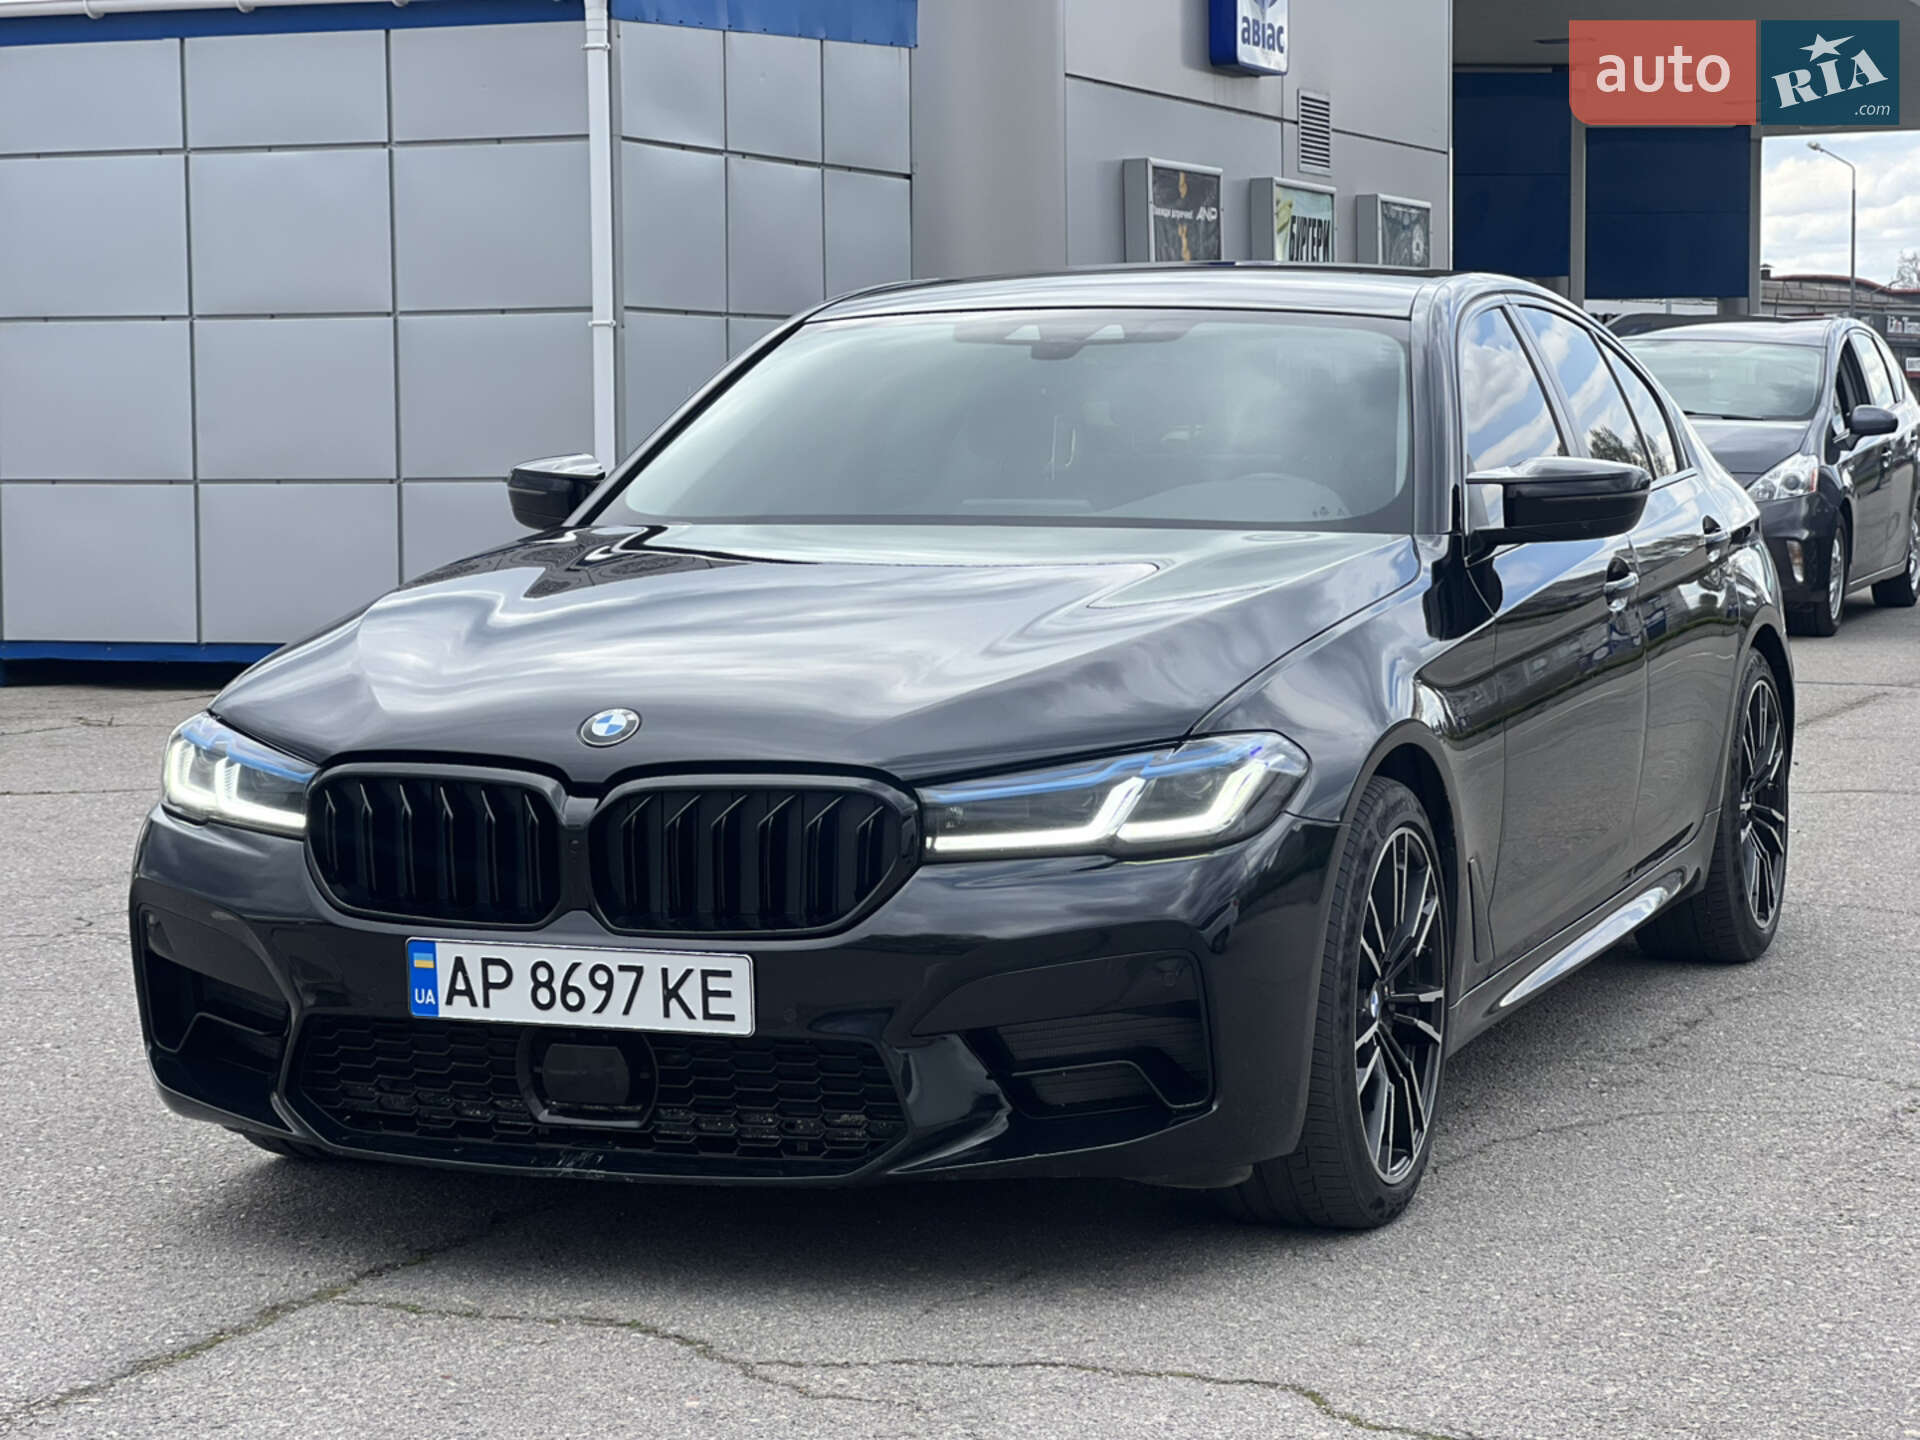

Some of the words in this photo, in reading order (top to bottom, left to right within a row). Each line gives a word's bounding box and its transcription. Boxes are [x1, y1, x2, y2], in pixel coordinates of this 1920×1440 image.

[414, 989, 436, 1005] UA
[445, 956, 513, 1009] AP
[530, 960, 644, 1016] 8697
[661, 967, 736, 1022] KE
